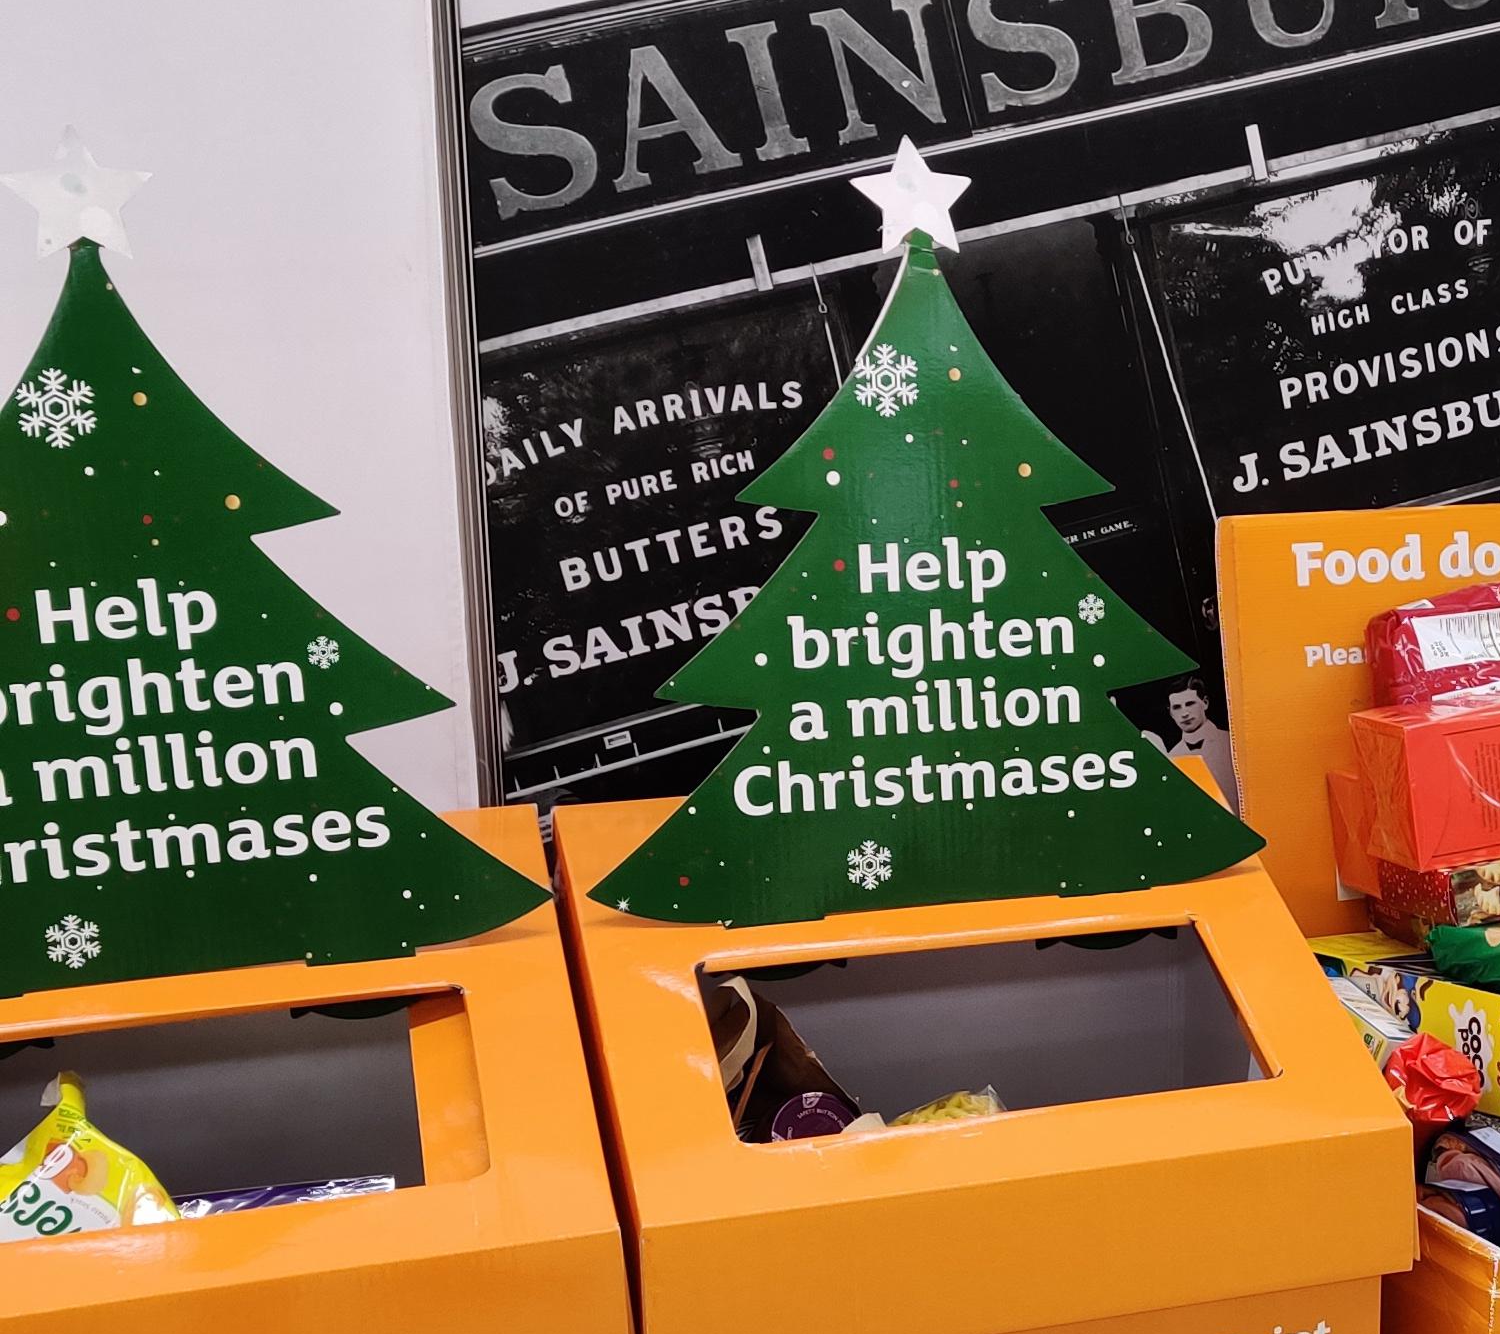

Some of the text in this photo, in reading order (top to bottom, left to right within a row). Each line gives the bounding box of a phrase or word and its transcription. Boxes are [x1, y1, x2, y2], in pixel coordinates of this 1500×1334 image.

[1453, 218, 1493, 247] OF
[1310, 278, 1470, 336] HIGH CLASS
[612, 380, 803, 436] ARRIVALS
[554, 449, 756, 518] OF PURE RICH
[1232, 451, 1271, 494] J.
[558, 505, 784, 593] BUTTERS
[857, 535, 1008, 604] Help
[1292, 531, 1426, 588] Food
[33, 577, 218, 650] Help
[786, 607, 1075, 679] brighten
[1304, 642, 1366, 668] Plea
[788, 675, 1082, 741] a million
[31, 729, 319, 804] million
[732, 749, 1139, 818] Christmases
[4, 803, 392, 884] ristmases
